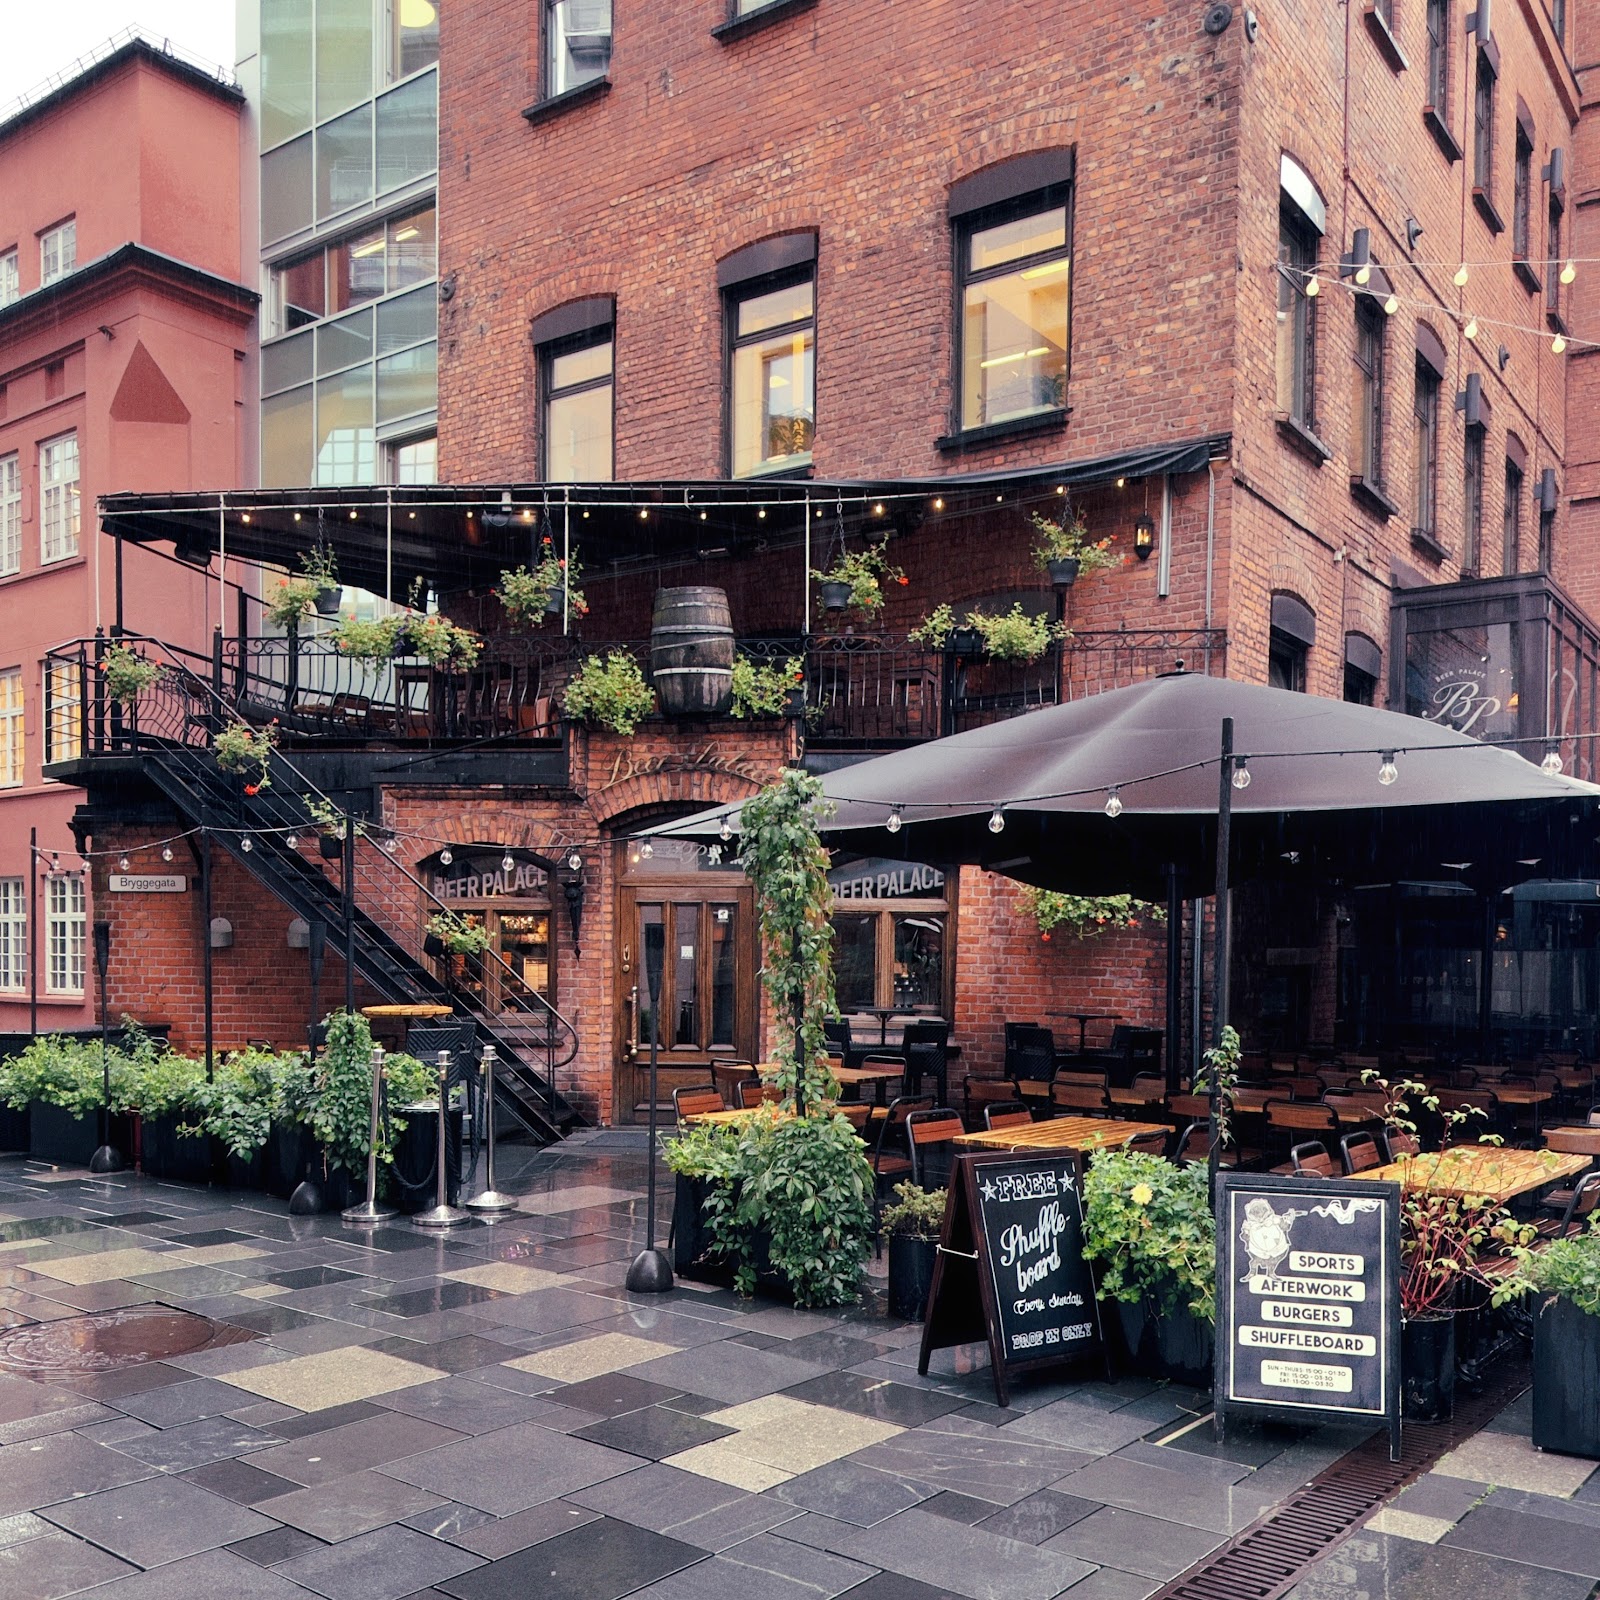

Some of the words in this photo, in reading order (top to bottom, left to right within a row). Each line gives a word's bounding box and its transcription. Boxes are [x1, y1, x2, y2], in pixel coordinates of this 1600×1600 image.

[1458, 668, 1487, 679] PALACE
[120, 877, 176, 890] Bryggegata
[482, 864, 548, 898] PALACE
[877, 865, 945, 898] PALACE
[996, 1170, 1058, 1202] FREE
[1016, 1237, 1061, 1292] board
[1298, 1254, 1355, 1271] SPORTS
[1261, 1279, 1353, 1298] AFTERWORK
[1013, 1298, 1046, 1315] Every
[1048, 1291, 1084, 1308] Sunday
[1272, 1305, 1340, 1322] BURGERS
[1011, 1330, 1044, 1350] DROP
[1045, 1327, 1060, 1344] IN
[1062, 1322, 1092, 1341] ONLY
[1250, 1330, 1364, 1351] SHUFFLEBOARD
